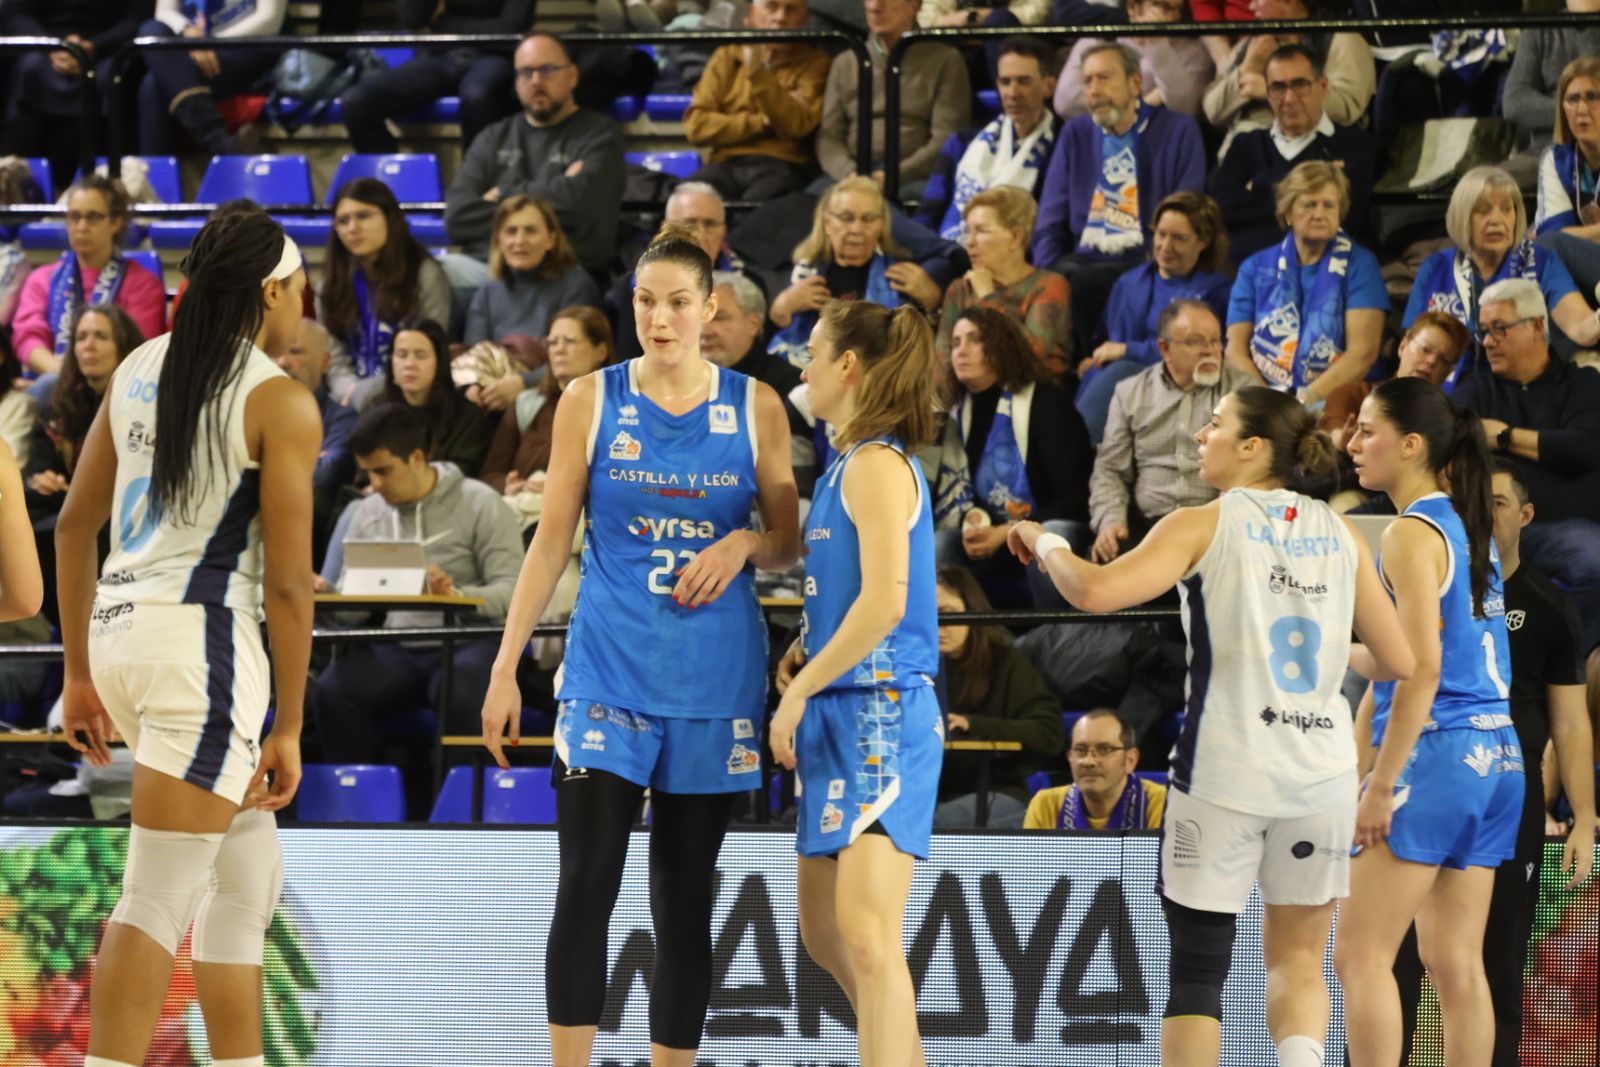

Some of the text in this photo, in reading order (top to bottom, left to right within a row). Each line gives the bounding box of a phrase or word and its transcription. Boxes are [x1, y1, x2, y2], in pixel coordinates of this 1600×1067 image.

[609, 468, 740, 488] CASTILLA Y LEÓN
[1269, 615, 1323, 694] 8
[1481, 631, 1510, 699] 1
